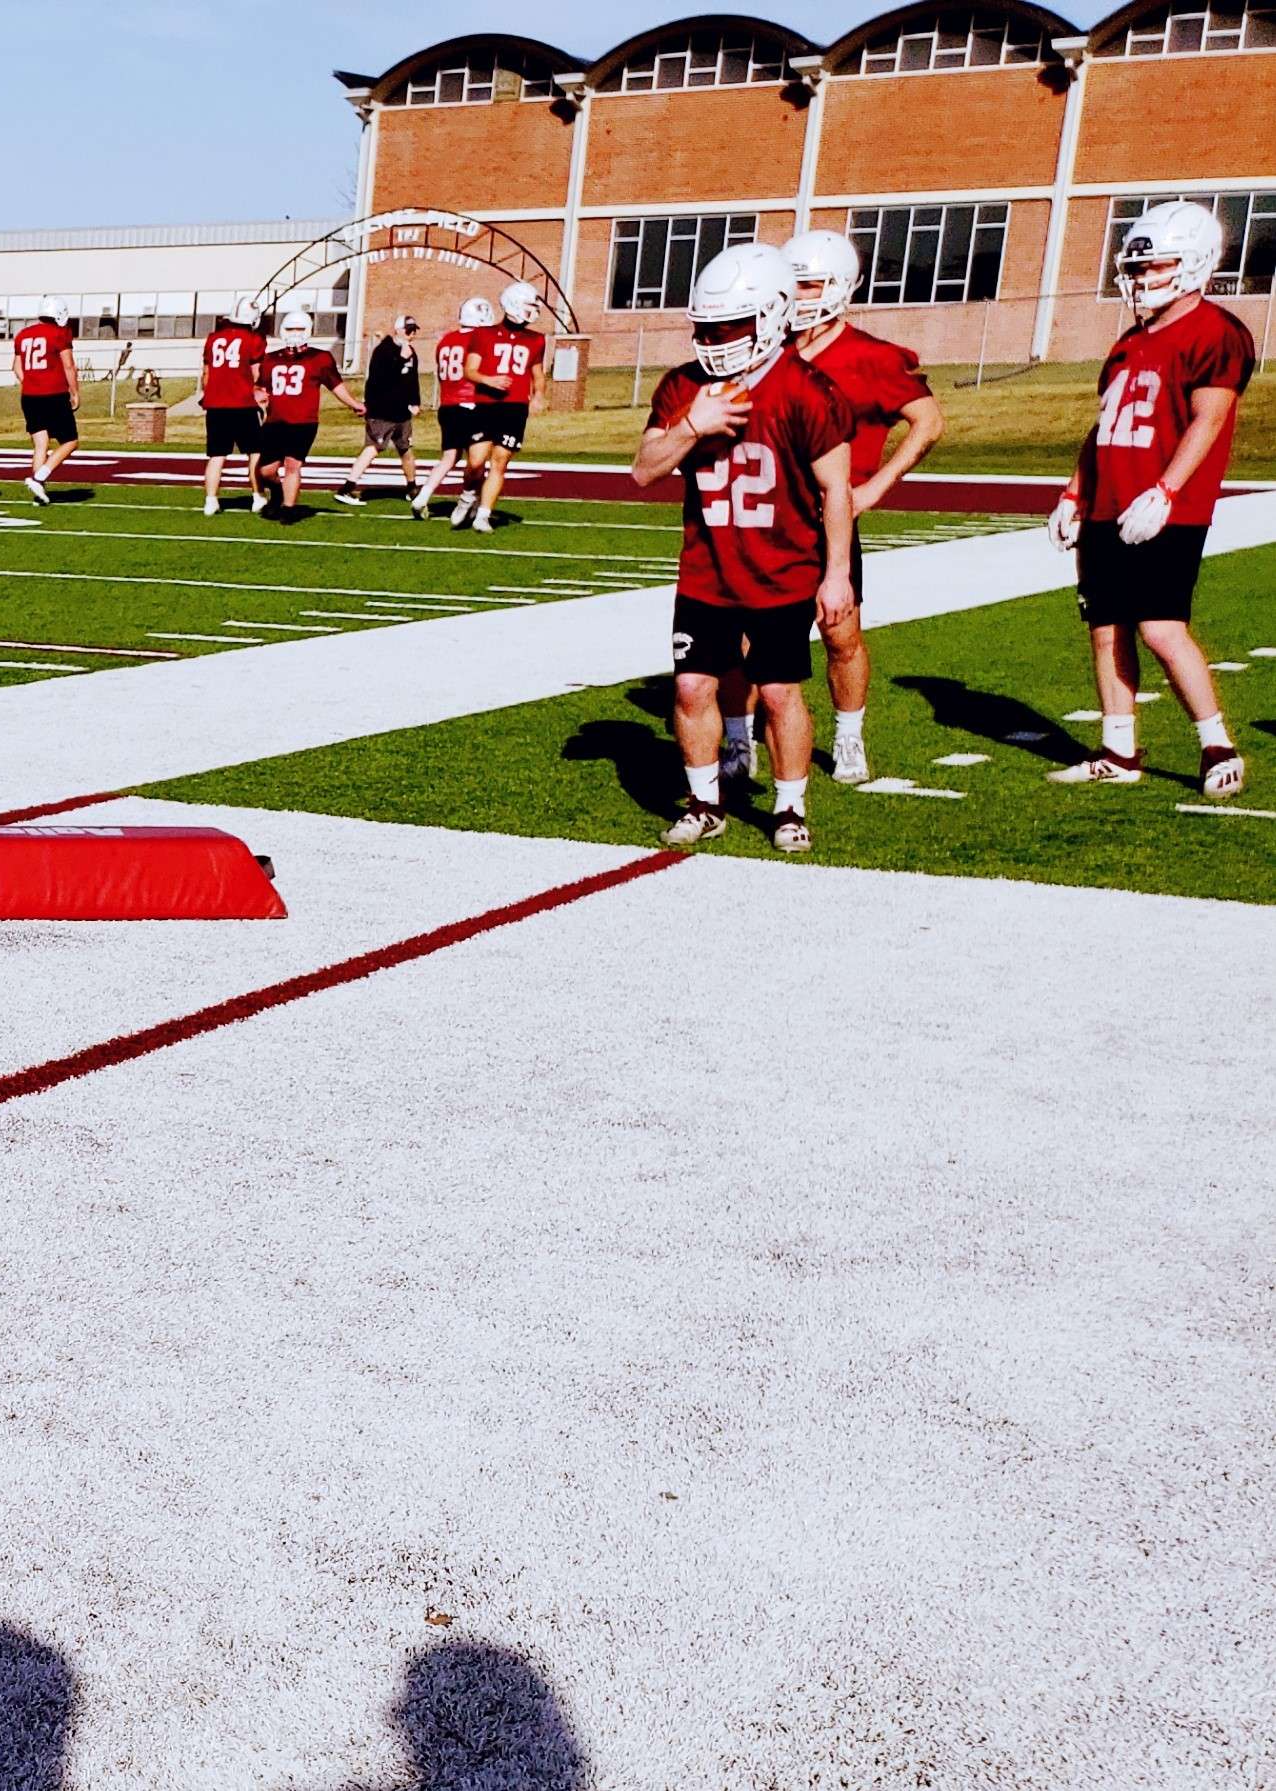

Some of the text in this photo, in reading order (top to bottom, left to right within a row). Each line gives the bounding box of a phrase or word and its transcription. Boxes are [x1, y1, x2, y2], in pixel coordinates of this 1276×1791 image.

[21, 337, 48, 371] 72
[211, 337, 242, 369] 64
[493, 342, 530, 376] 79
[271, 364, 306, 396] 63
